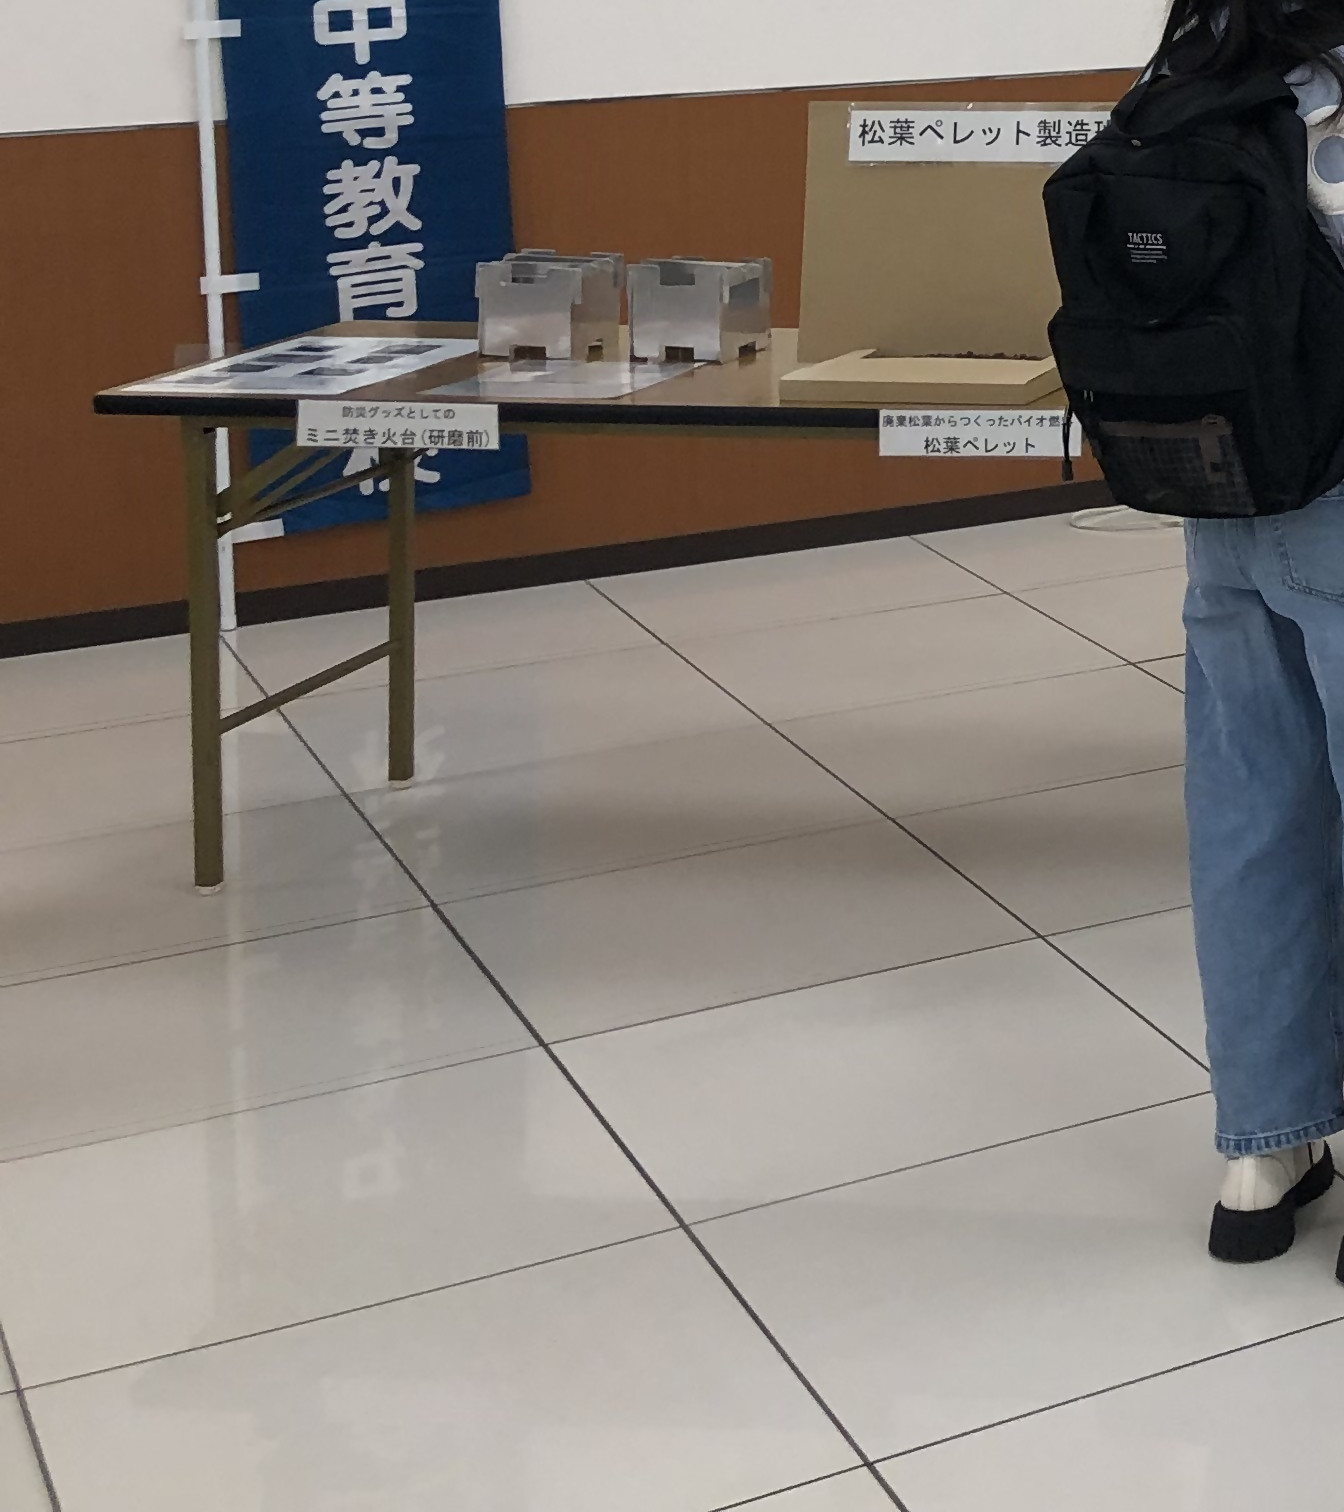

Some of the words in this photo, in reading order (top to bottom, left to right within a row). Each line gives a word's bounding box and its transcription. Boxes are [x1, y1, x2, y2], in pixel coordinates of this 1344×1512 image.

[1127, 232, 1163, 244] TACTICS
[342, 406, 455, 421] 防災グッズとしての
[307, 427, 490, 448] ミニ焚き火台(研磨前)
[924, 436, 1036, 455] 松葉ペレット
